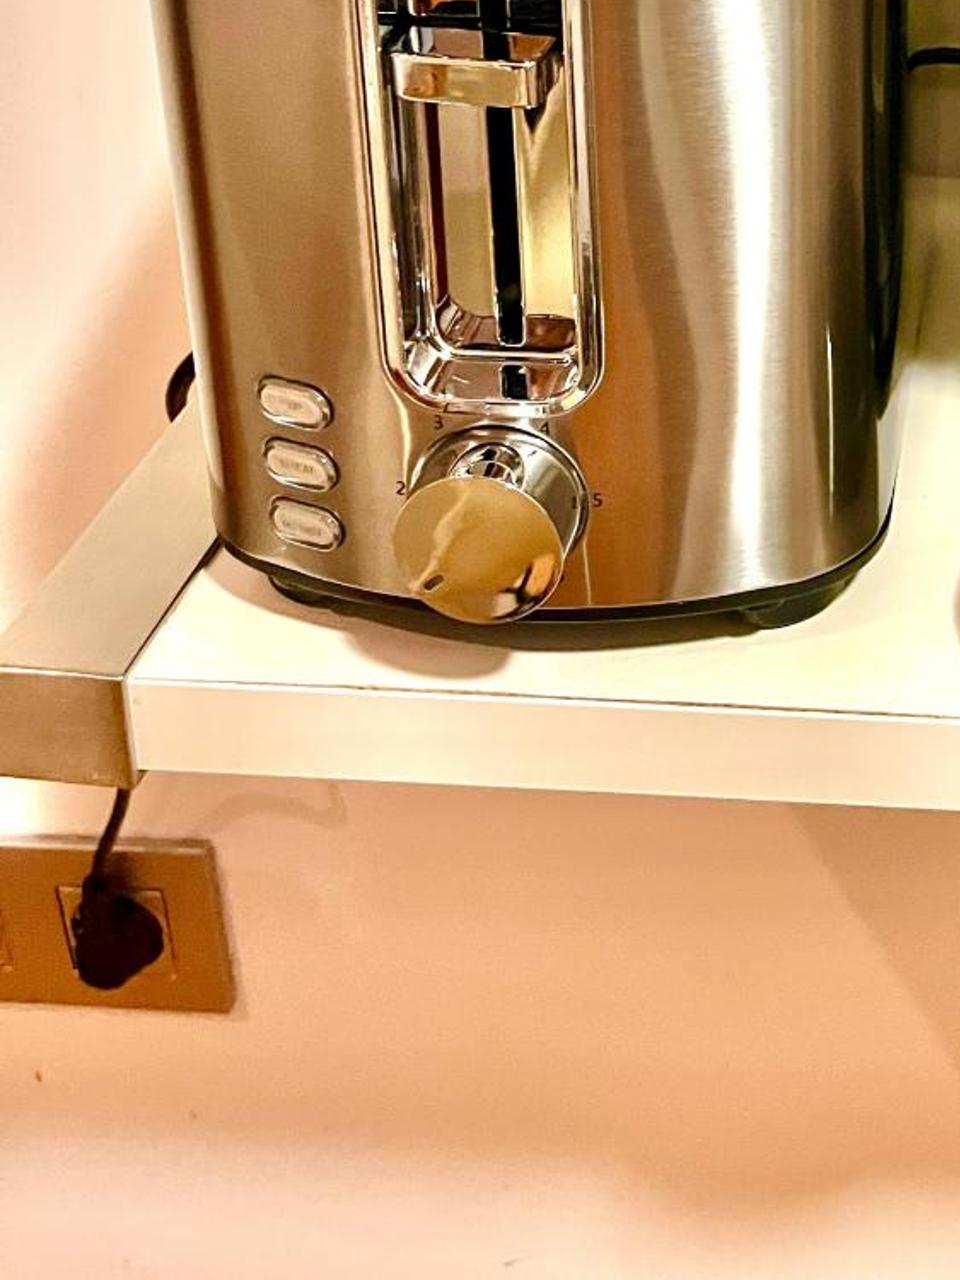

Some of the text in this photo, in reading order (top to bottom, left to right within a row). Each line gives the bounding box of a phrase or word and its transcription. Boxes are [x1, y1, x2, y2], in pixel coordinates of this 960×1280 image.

[433, 415, 445, 429] 3
[395, 480, 406, 495] 2
[592, 493, 603, 508] 5
